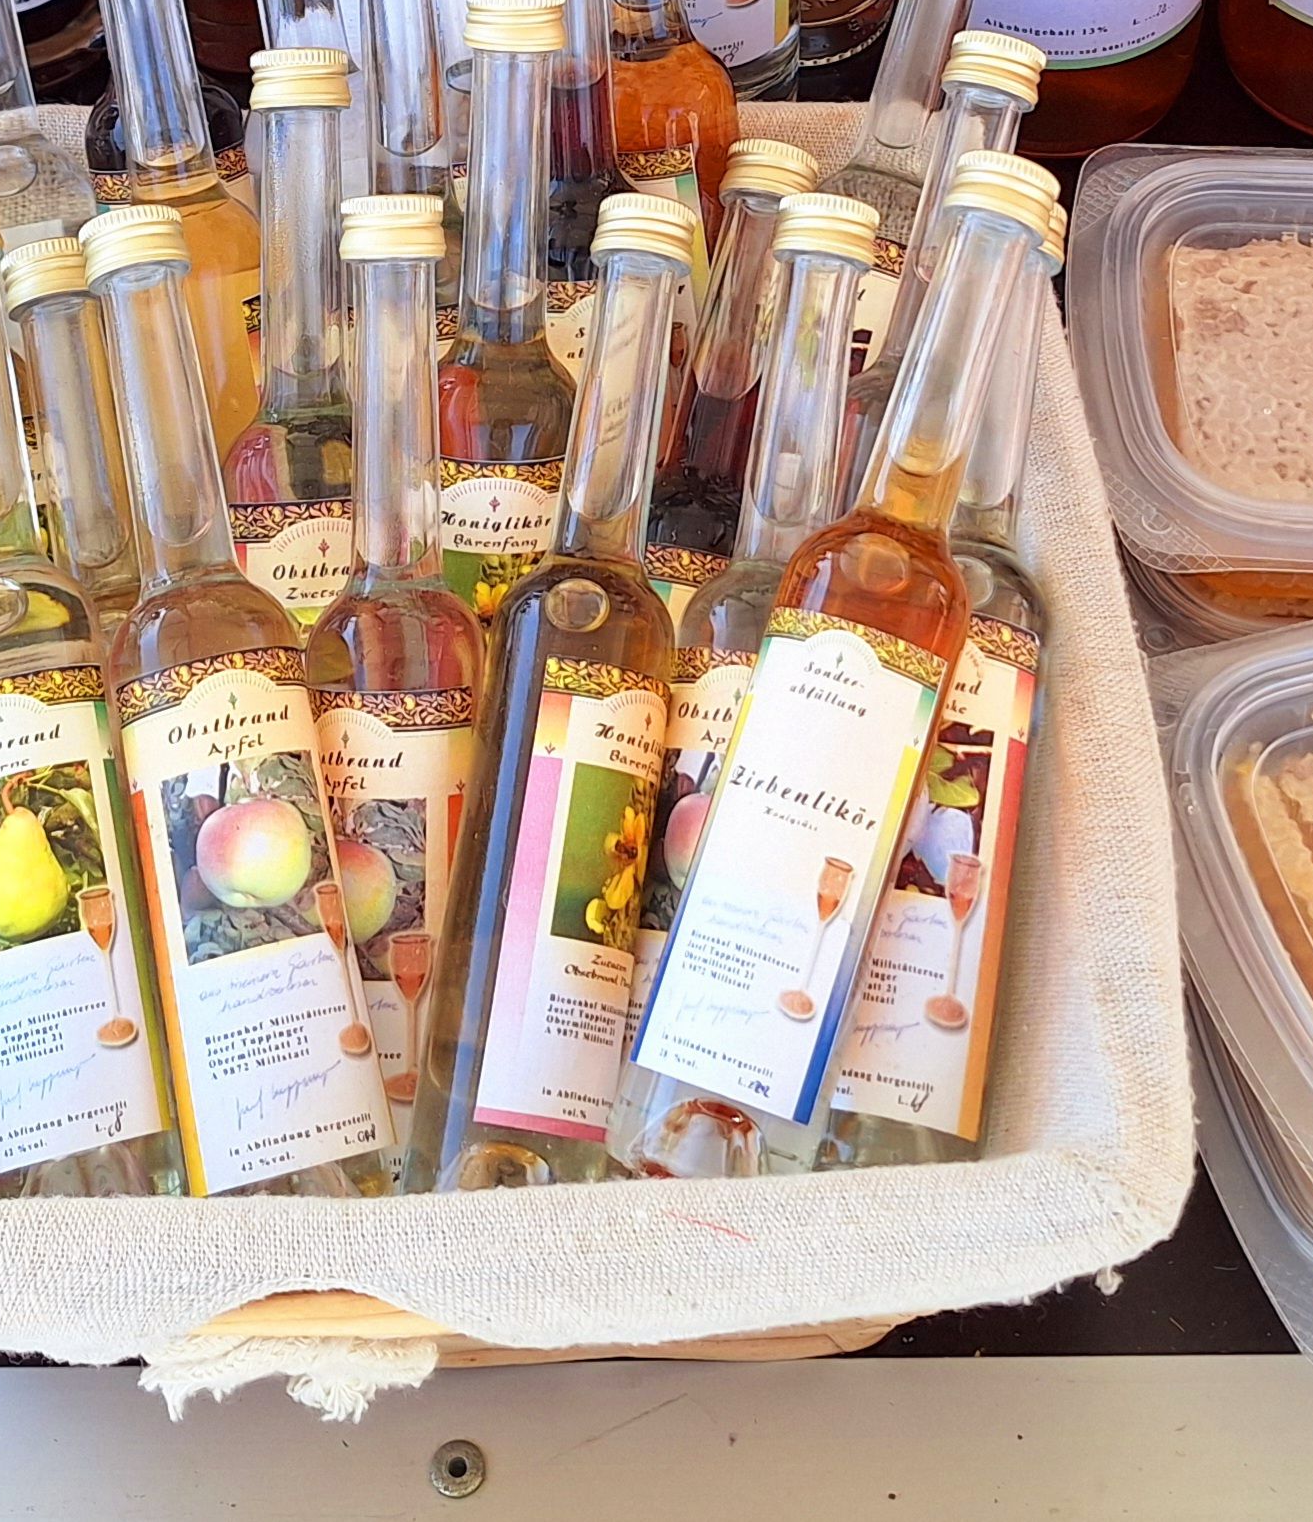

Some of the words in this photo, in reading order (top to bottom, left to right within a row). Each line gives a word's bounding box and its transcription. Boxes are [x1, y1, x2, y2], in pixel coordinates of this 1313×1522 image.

[984, 17, 1076, 36] Alkoholgehalt
[440, 509, 552, 533] Honiglikör
[452, 533, 539, 552] Bärenfang
[272, 562, 351, 583] Obstbra
[802, 658, 867, 691] Sonder-
[788, 681, 868, 718] abfüllung
[167, 704, 290, 746] Obstbrand
[207, 734, 266, 760] Apfel
[729, 766, 878, 833] Zirbenlikör
[711, 969, 751, 990] Millstatt
[547, 1004, 574, 1016] Josef
[550, 994, 597, 1009] Bienenhof
[205, 1022, 265, 1045] Bienenhof
[557, 1028, 579, 1038] 9872
[16, 1044, 64, 1063] Millstatt
[207, 1042, 236, 1057] Josef
[208, 1040, 291, 1069] Obermillstatt
[223, 1064, 250, 1076] 9872
[255, 1048, 311, 1068] Millstatt
[7, 1118, 63, 1141] Abfindung
[246, 1130, 311, 1152] Abfindung
[316, 1112, 372, 1134] hergestellt
[241, 1161, 254, 1172] 42
